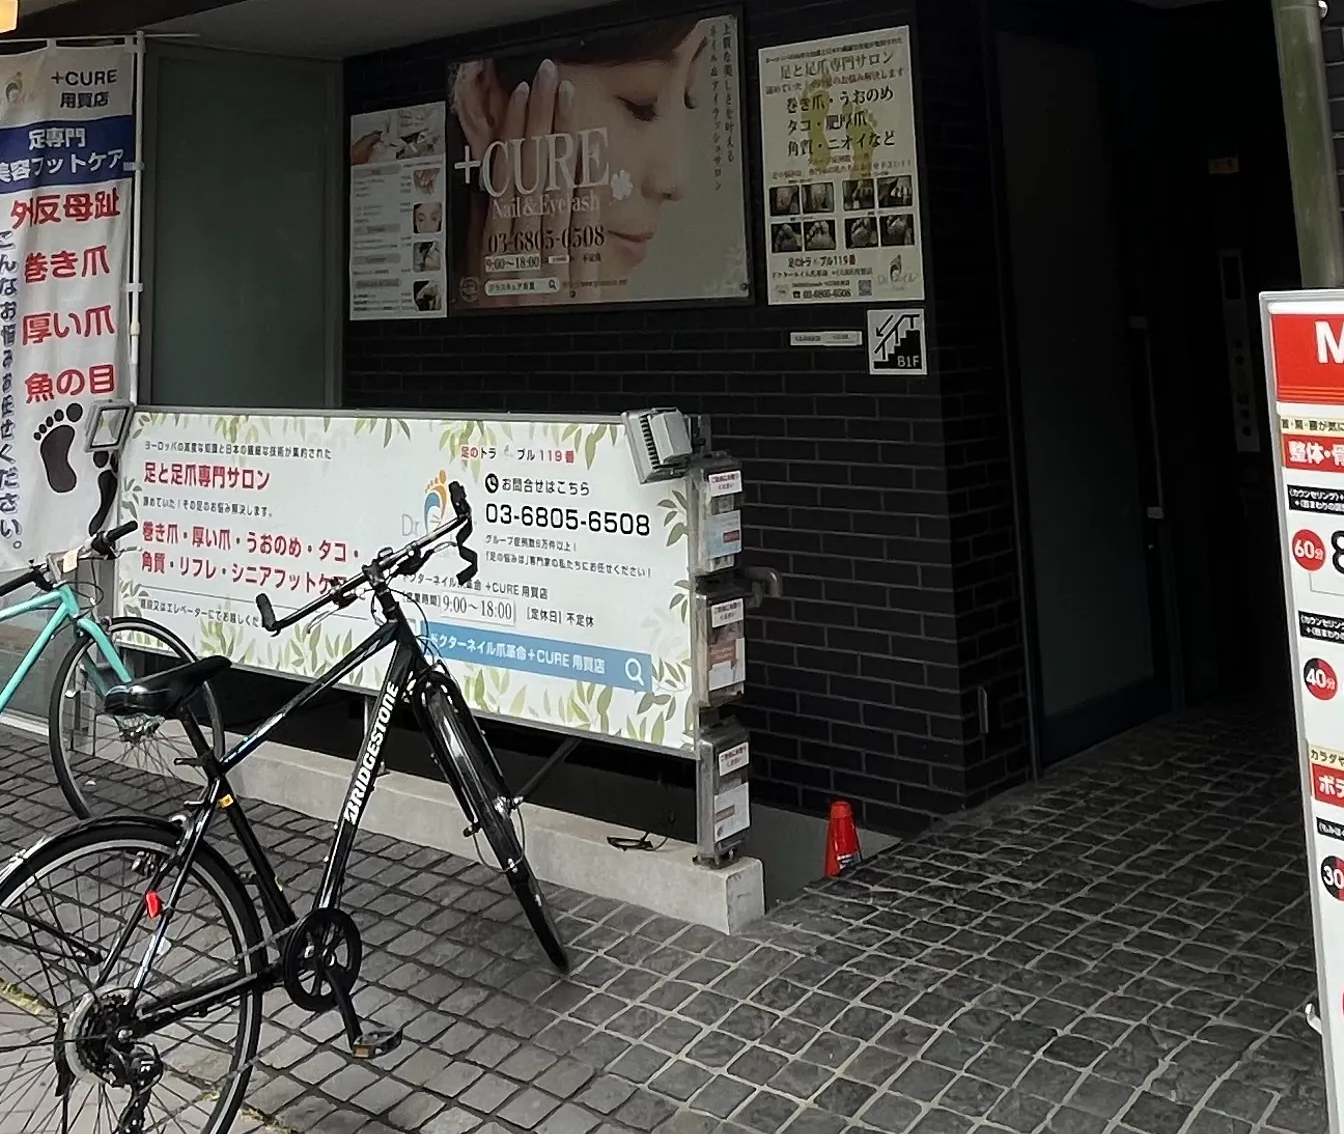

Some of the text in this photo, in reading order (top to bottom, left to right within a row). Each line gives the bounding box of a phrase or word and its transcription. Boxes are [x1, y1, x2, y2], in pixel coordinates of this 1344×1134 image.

[51, 68, 118, 87] +CURE
[780, 51, 894, 80] 足と足爪専門サロン
[60, 91, 109, 109] 用賀店
[786, 85, 894, 114] 巻き爪・うおのめ
[788, 110, 867, 135] タコ・肥厚爪
[28, 127, 87, 150] 足専門
[787, 130, 896, 157] 角質・ニオイなど
[10, 187, 121, 230] 外反母趾
[23, 245, 111, 284] 巻き爪
[22, 304, 115, 346] 厚い爪
[896, 355, 919, 368] B1F
[24, 364, 115, 404] 魚の目
[143, 461, 271, 490] 足と足爪専門サロン
[501, 478, 590, 496] お問合せはこちら
[485, 503, 650, 536] 03-6805-6508
[1294, 539, 1324, 561] 60分
[403, 572, 549, 600] クターネイル革命 +CURE 用賀店
[140, 598, 260, 628] 階段又はエレベーターにてお越しくだ
[566, 611, 595, 628] 不定休
[572, 652, 606, 675] 用賀店
[1306, 668, 1336, 689] 40分
[344, 681, 399, 826] BRIDGESTONE
